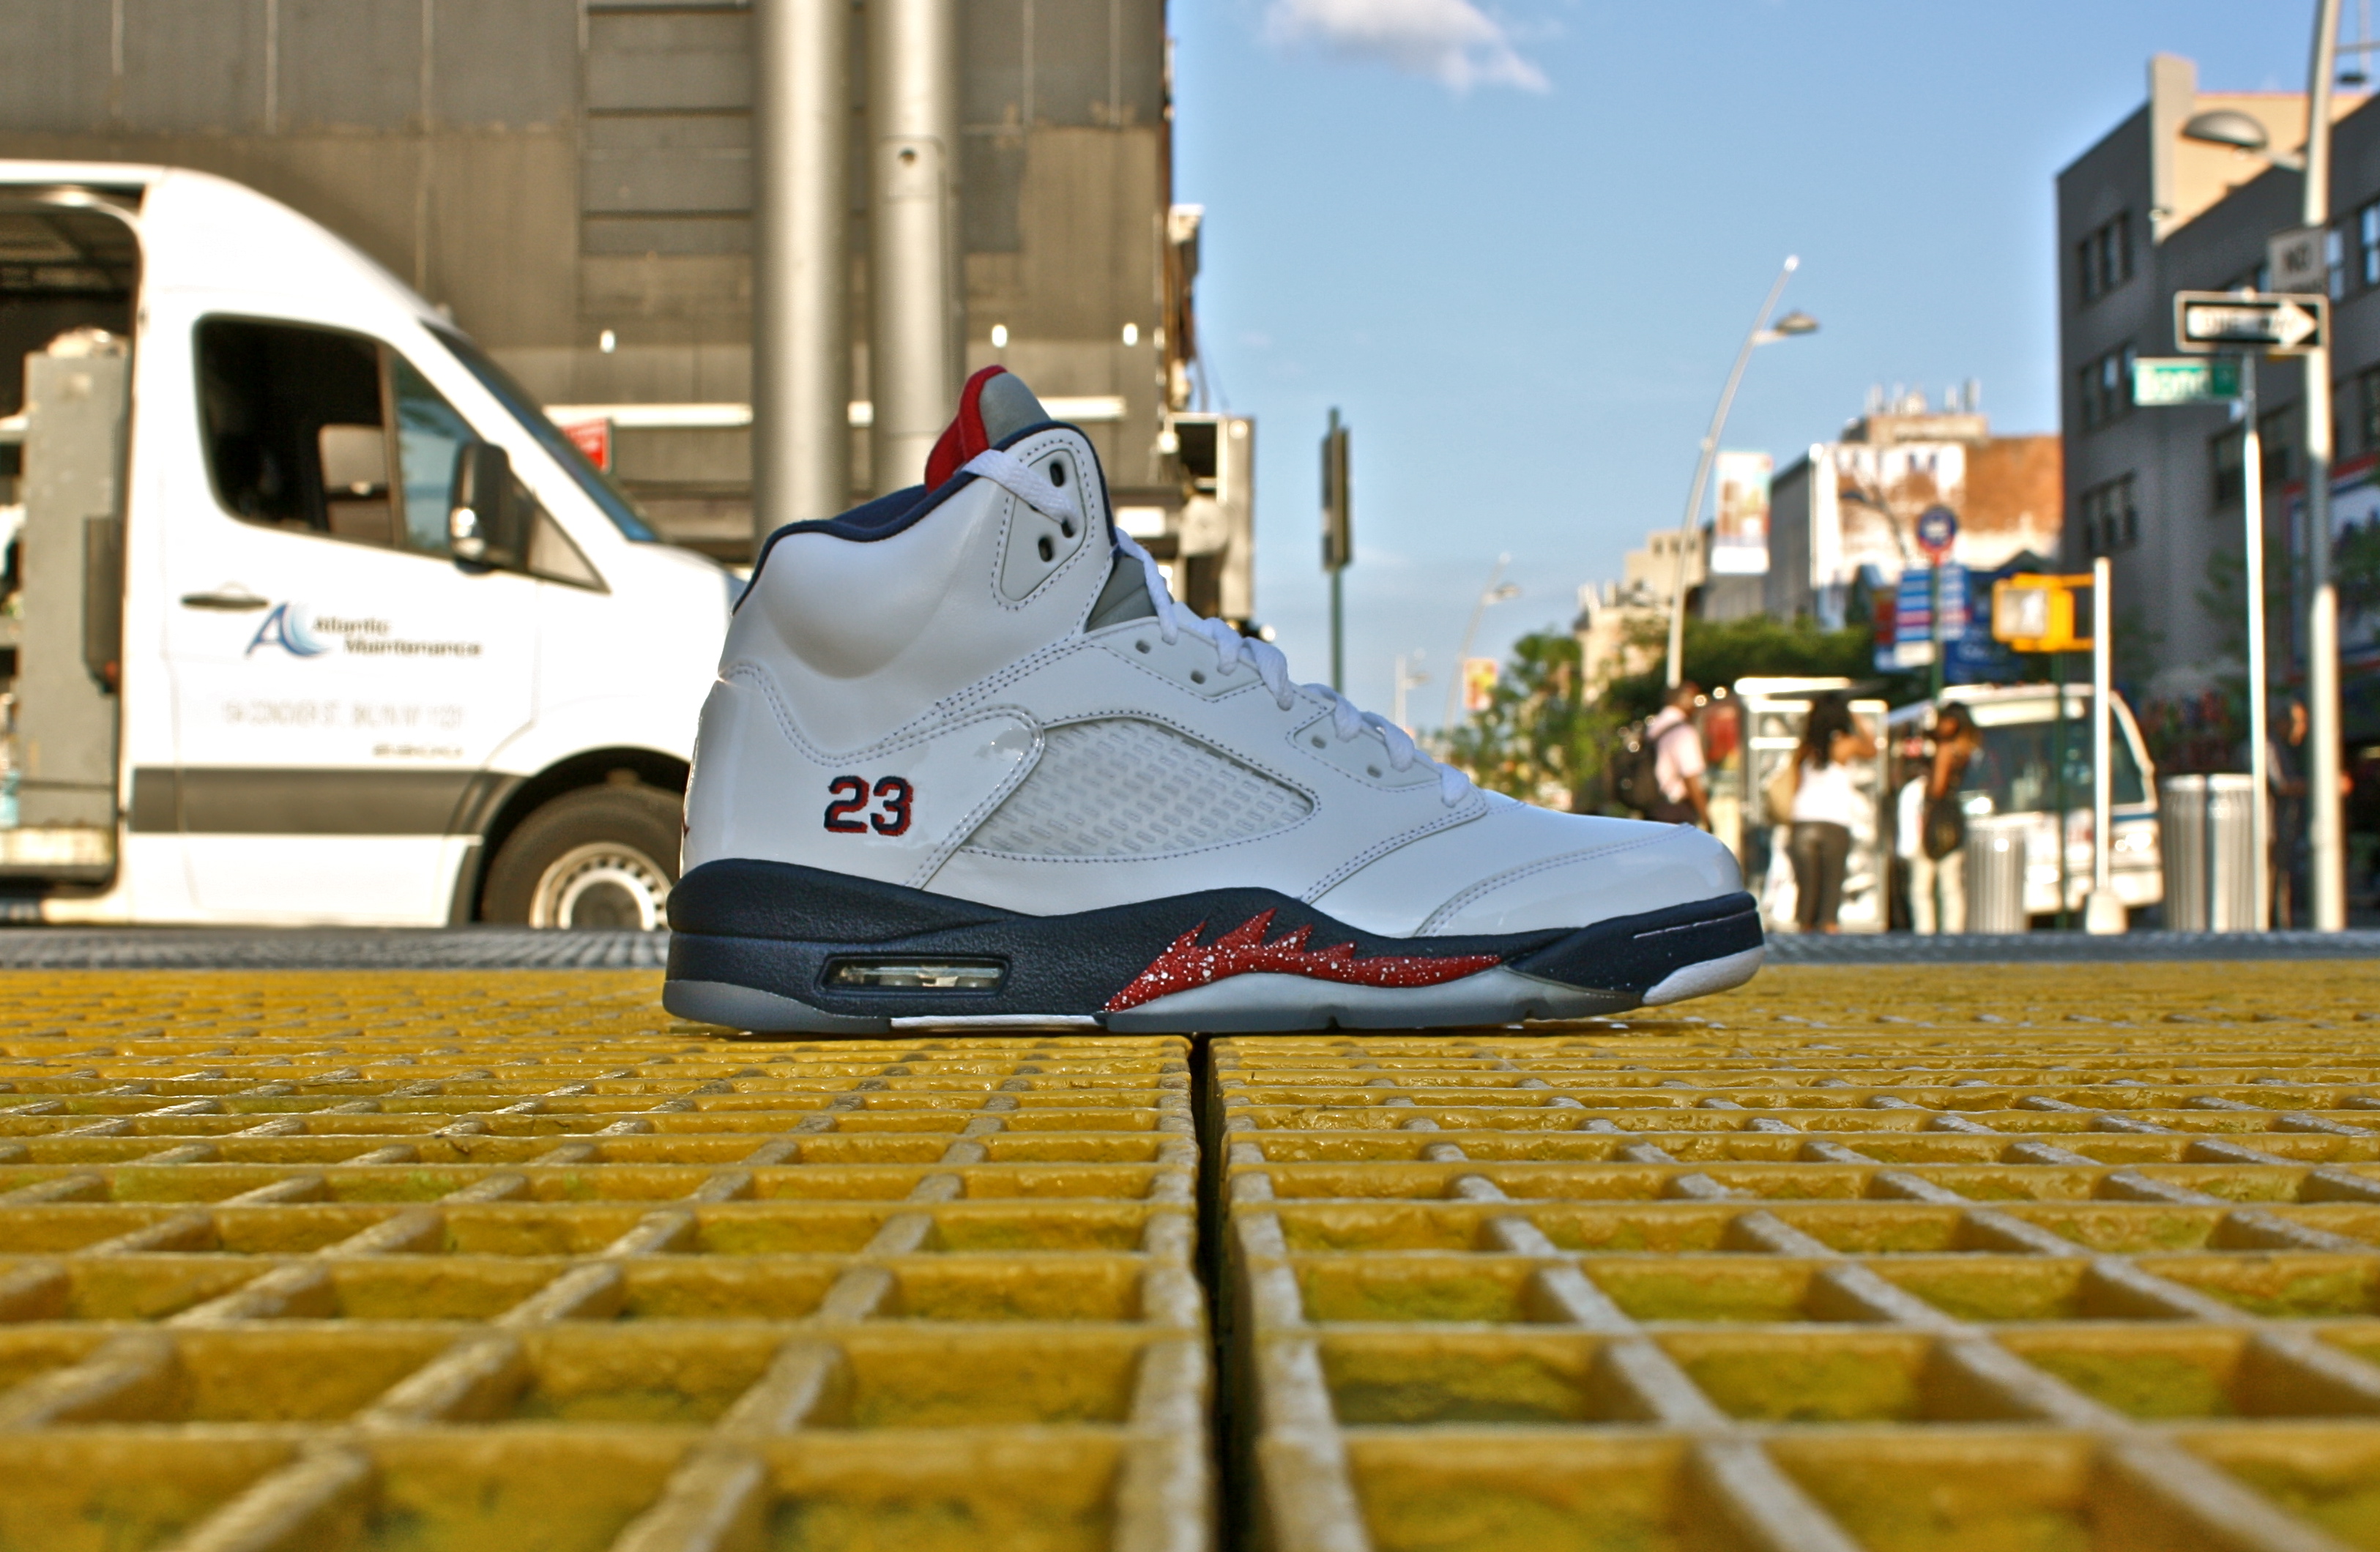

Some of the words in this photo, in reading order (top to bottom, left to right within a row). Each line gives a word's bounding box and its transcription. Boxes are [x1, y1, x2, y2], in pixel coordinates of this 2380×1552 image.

[314, 617, 389, 635] Atlantic
[345, 638, 480, 657] Maintenance
[825, 776, 914, 836] 23
